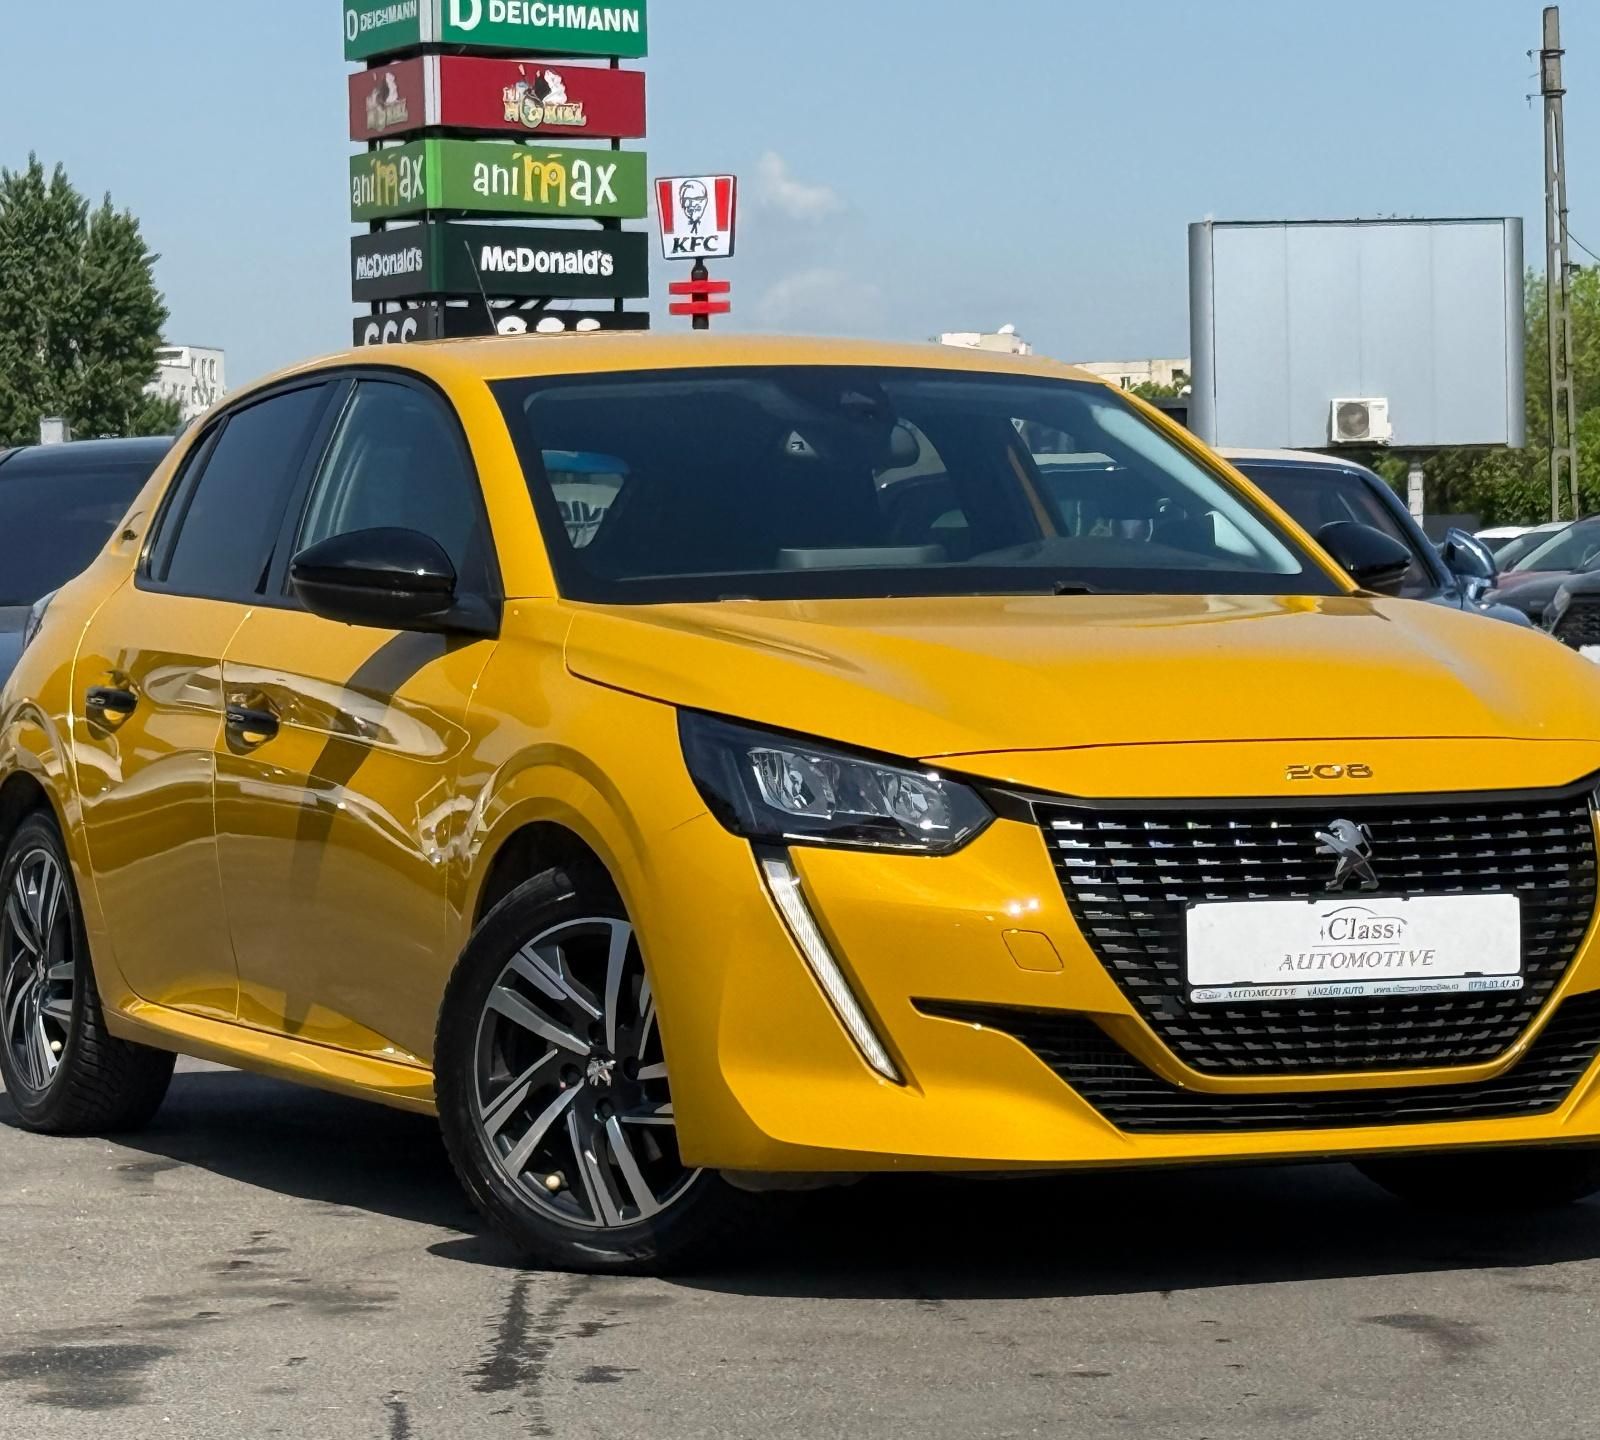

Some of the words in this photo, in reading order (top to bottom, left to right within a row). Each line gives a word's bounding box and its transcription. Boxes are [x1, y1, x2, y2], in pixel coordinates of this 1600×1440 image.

[360, 0, 417, 31] DEICHMANN
[489, 0, 640, 33] DEICHMANN
[352, 154, 425, 207] animax
[473, 152, 618, 207] animax
[481, 245, 614, 276] McDonald's
[672, 235, 720, 255] KFC
[356, 247, 424, 280] McDonald's
[1285, 763, 1373, 780] 208
[1328, 917, 1395, 941] Class
[1279, 949, 1436, 972] AUTOMOTIVE
